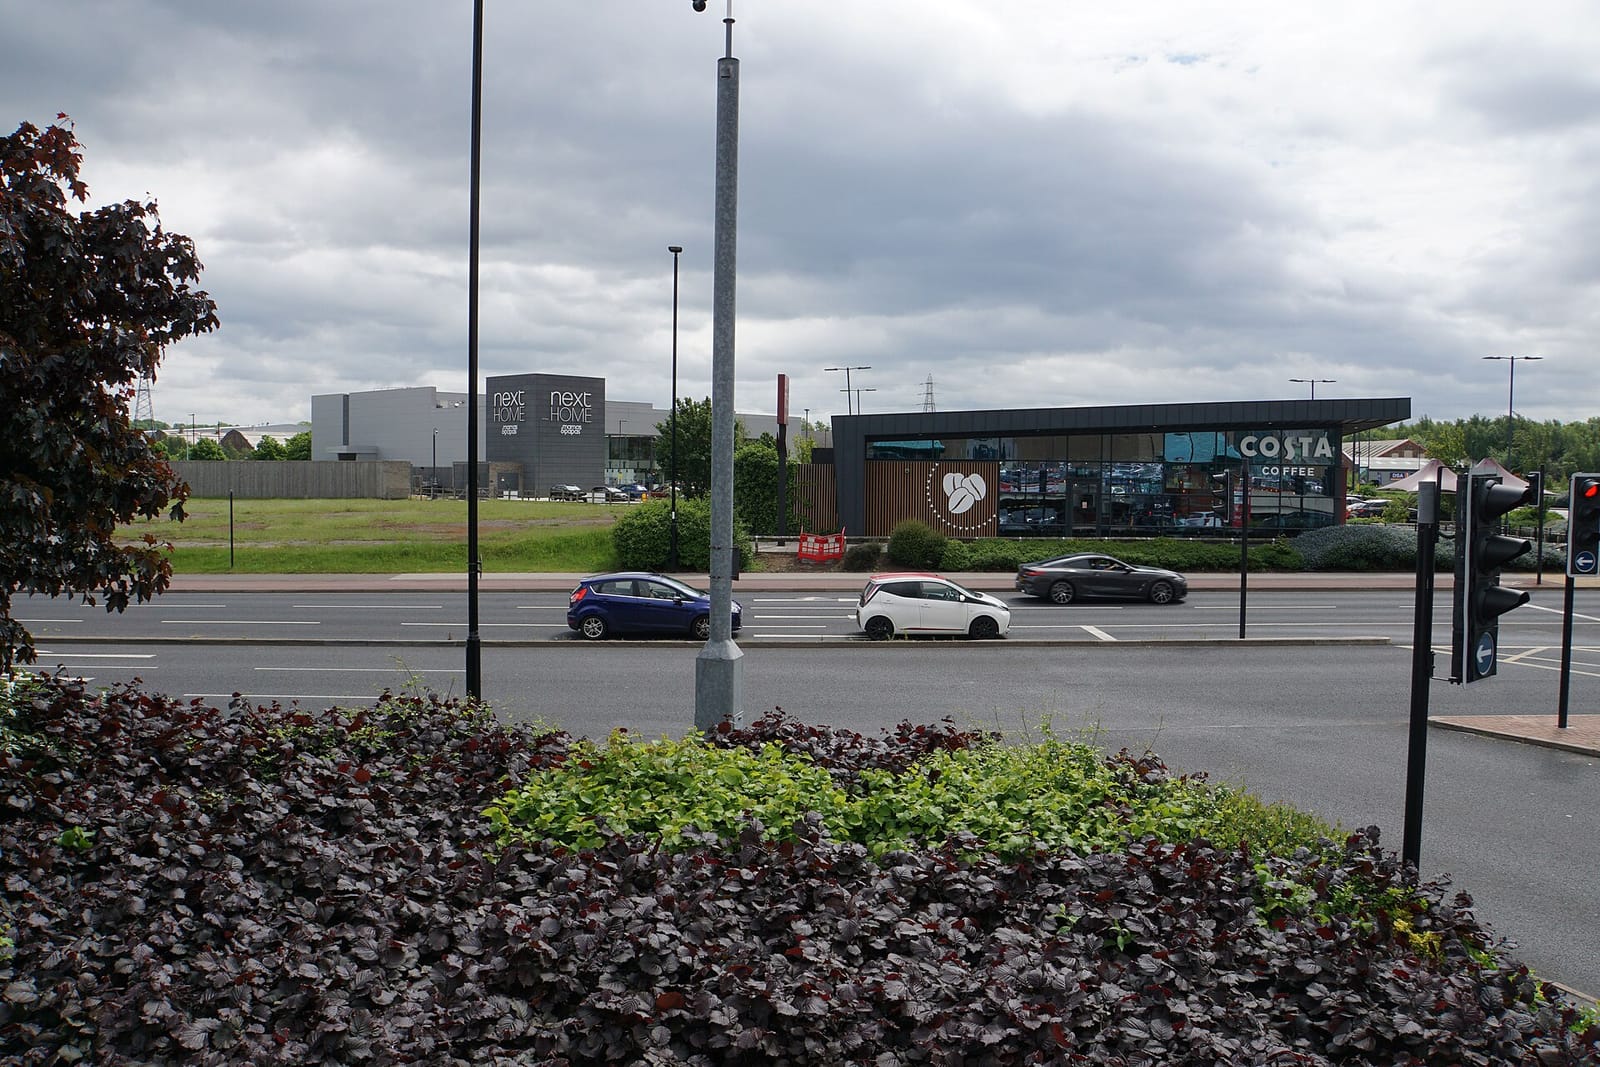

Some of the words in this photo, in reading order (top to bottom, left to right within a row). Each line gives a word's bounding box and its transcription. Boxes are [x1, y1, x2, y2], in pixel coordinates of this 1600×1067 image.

[494, 390, 525, 407] next
[550, 391, 592, 407] next
[493, 407, 525, 422] HOME
[550, 407, 592, 423] HOME
[1240, 435, 1333, 460] COSTA
[1262, 466, 1315, 476] COFFEE
